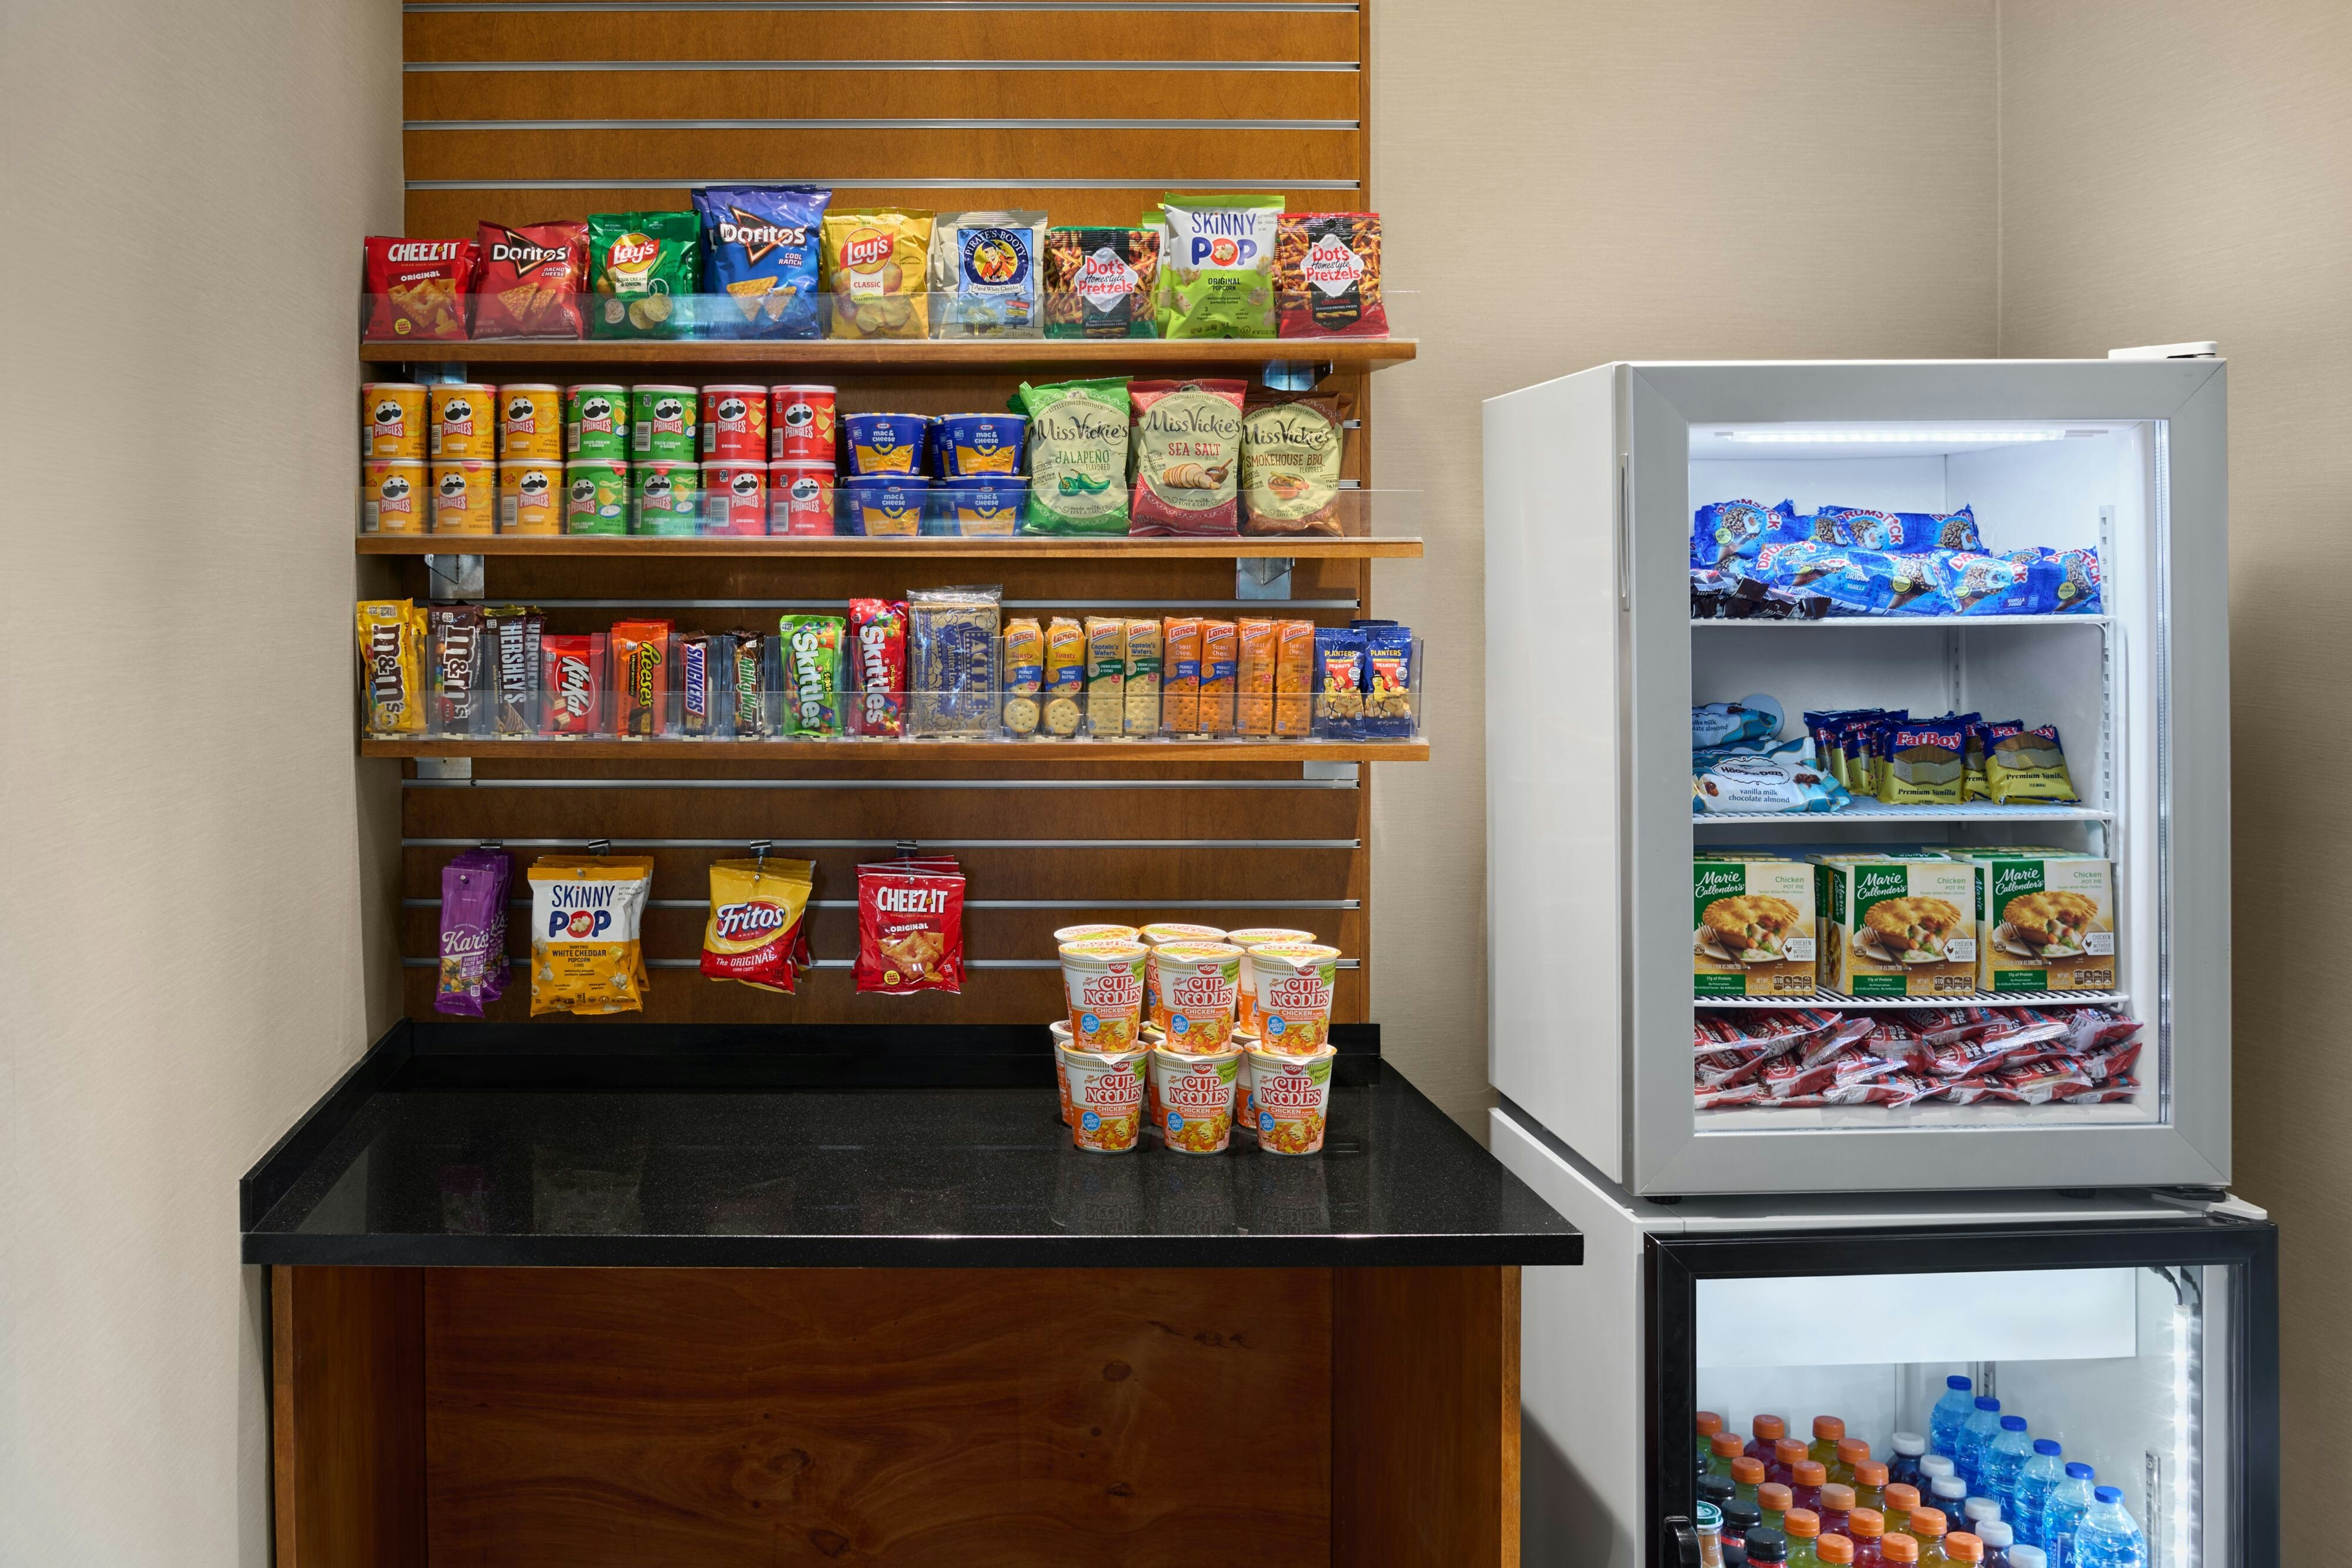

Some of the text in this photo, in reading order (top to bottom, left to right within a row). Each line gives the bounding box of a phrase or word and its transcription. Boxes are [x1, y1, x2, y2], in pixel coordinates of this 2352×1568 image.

[720, 225, 806, 245] Doritos
[848, 236, 888, 265] Lay's
[965, 230, 1025, 256] PIRATE'S BOOTY
[494, 245, 567, 260] Doritos
[613, 242, 654, 265] Lay's
[1192, 237, 1257, 266] POP
[1313, 245, 1349, 261] Dot's
[1087, 258, 1124, 275] Dot's
[1312, 260, 1350, 271] Homestyle
[1085, 273, 1124, 285] Homestyle
[1306, 267, 1361, 281] Pretzels
[1079, 280, 1133, 294] Pretzels
[1048, 403, 1064, 413] KETTLE
[375, 423, 403, 436] PRINGLES
[507, 420, 533, 433] PRINGLES
[583, 420, 610, 432] PRINGLES
[654, 420, 682, 433] PRINGLES
[718, 420, 746, 433] PRINGLES
[1038, 413, 1128, 445] Miss Vickie's
[1145, 406, 1240, 439] Miss Vickie's
[786, 426, 813, 438] PRINGLES
[1242, 419, 1329, 450] Miss Vickie's
[1055, 449, 1110, 464] JALAPEÑO
[1169, 443, 1220, 456] SEA SALT
[1247, 454, 1325, 468] SMOKEHOUSE BBQ
[382, 498, 410, 512] PRINGLES
[520, 494, 548, 507] PRINGLES
[791, 500, 818, 513] PRINGLES
[1053, 632, 1077, 643] Lance
[1092, 626, 1117, 637] Lance
[1129, 624, 1153, 636] Lance
[1208, 627, 1232, 639] Lance
[1284, 626, 1308, 637] Lance
[500, 625, 526, 703] HERSHEY'S
[947, 645, 956, 670] Butter
[971, 638, 987, 678] ACT
[639, 641, 662, 708] Reese's
[687, 646, 704, 715] SNICKERS
[793, 632, 824, 728] Skittles
[860, 625, 890, 724] Skittles
[737, 657, 757, 722] Milky Way
[1896, 731, 1962, 749] FatBoy
[1695, 871, 1741, 886] Marie
[1857, 873, 1903, 888] Marie
[1996, 868, 2040, 884] Marie
[1695, 883, 1745, 898] Callender's
[1857, 885, 1907, 900] Callender's
[1996, 880, 2044, 895] Callender's
[549, 910, 612, 938] POP
[717, 902, 785, 938] Fritos
[716, 952, 777, 967] The ORIGINAL
[1098, 975, 1135, 991] CUP
[1187, 976, 1225, 992] CUP
[1084, 987, 1141, 1006] NOODLES
[1174, 988, 1233, 1007] NOODLES
[1182, 1076, 1222, 1091] CUP
[1273, 1076, 1314, 1092] CUP
[1169, 1086, 1230, 1105] NOODLES
[1261, 1086, 1322, 1106] NOODLES
